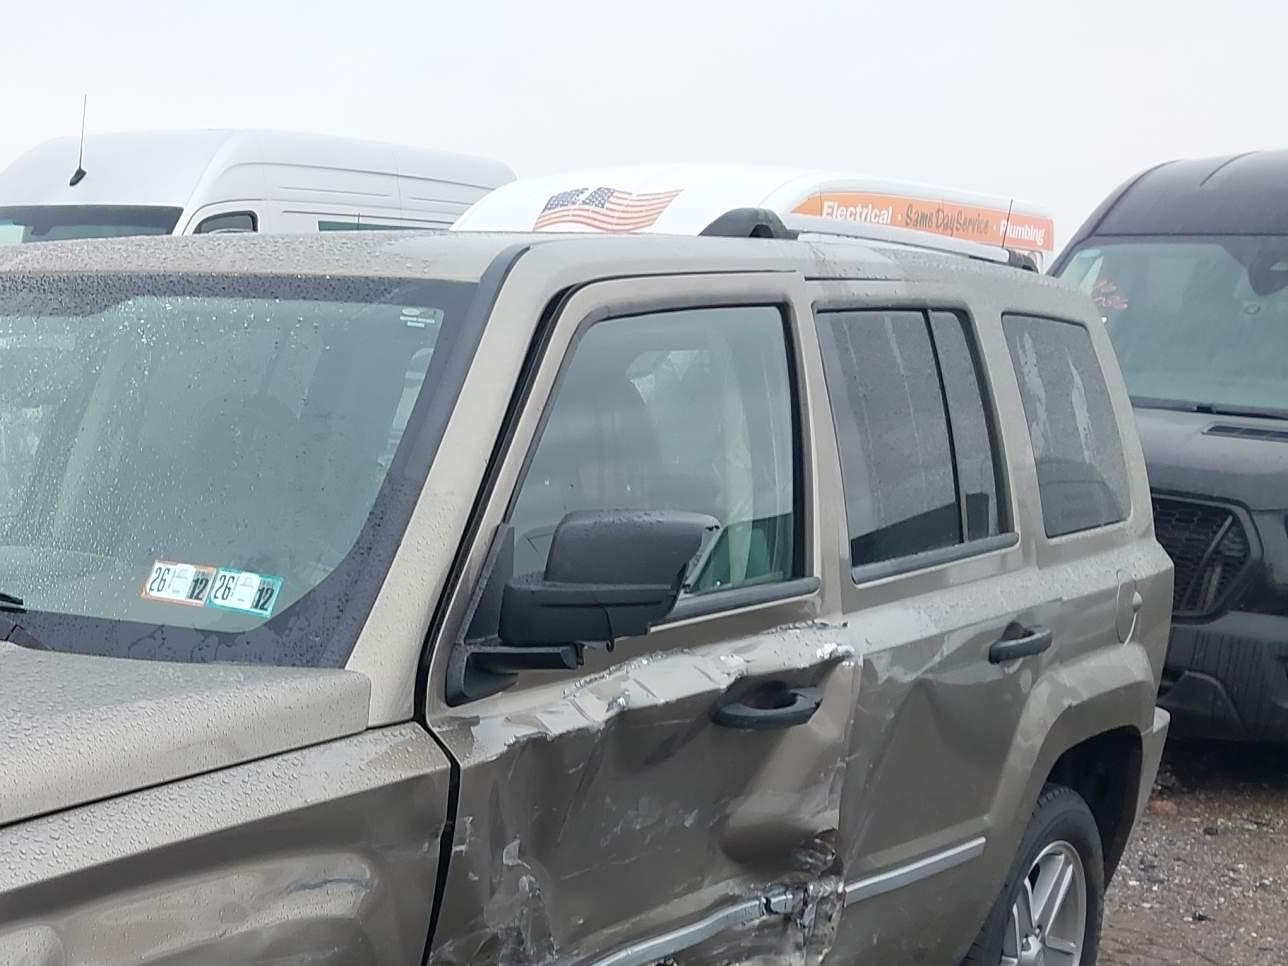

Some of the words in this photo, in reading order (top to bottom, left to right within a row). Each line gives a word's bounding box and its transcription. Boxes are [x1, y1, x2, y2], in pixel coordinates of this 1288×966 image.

[822, 200, 893, 225] Electrical
[905, 203, 934, 229] Same
[999, 218, 1046, 245] Plumbing
[149, 566, 170, 593] 26
[188, 577, 209, 601] 12
[213, 574, 235, 601] 26
[253, 586, 274, 611] 12
